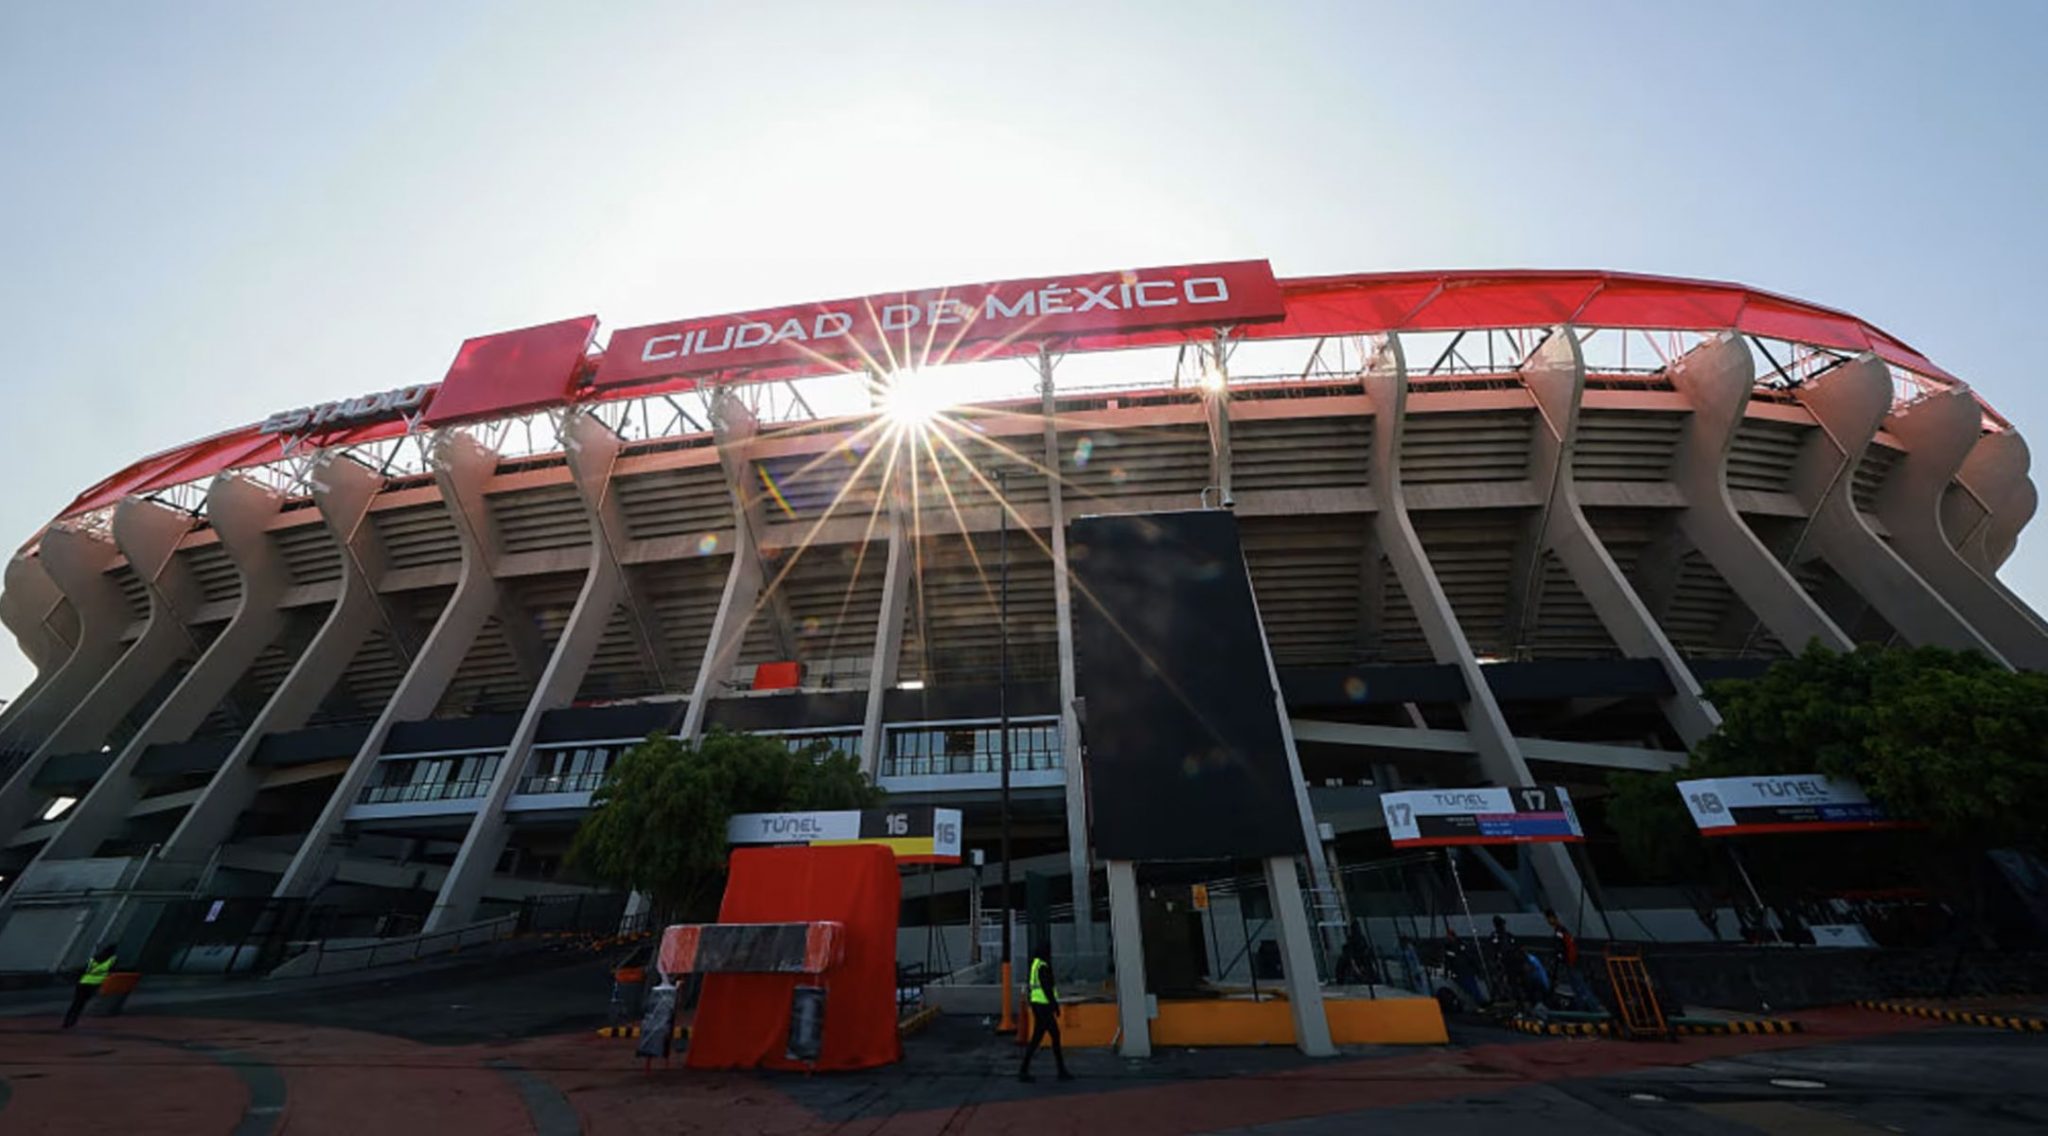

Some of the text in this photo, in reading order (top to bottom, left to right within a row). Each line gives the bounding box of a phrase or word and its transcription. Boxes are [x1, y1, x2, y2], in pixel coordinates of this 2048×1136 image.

[641, 276, 1230, 362] CIUDAD DE MÉXICO
[260, 383, 428, 434] ESTADIO
[1522, 789, 1546, 811] 17
[1690, 792, 1724, 815] 18
[761, 815, 823, 833] TÚNEL
[886, 813, 909, 835] 16
[1386, 802, 1412, 827] 17
[936, 823, 956, 845] 16
